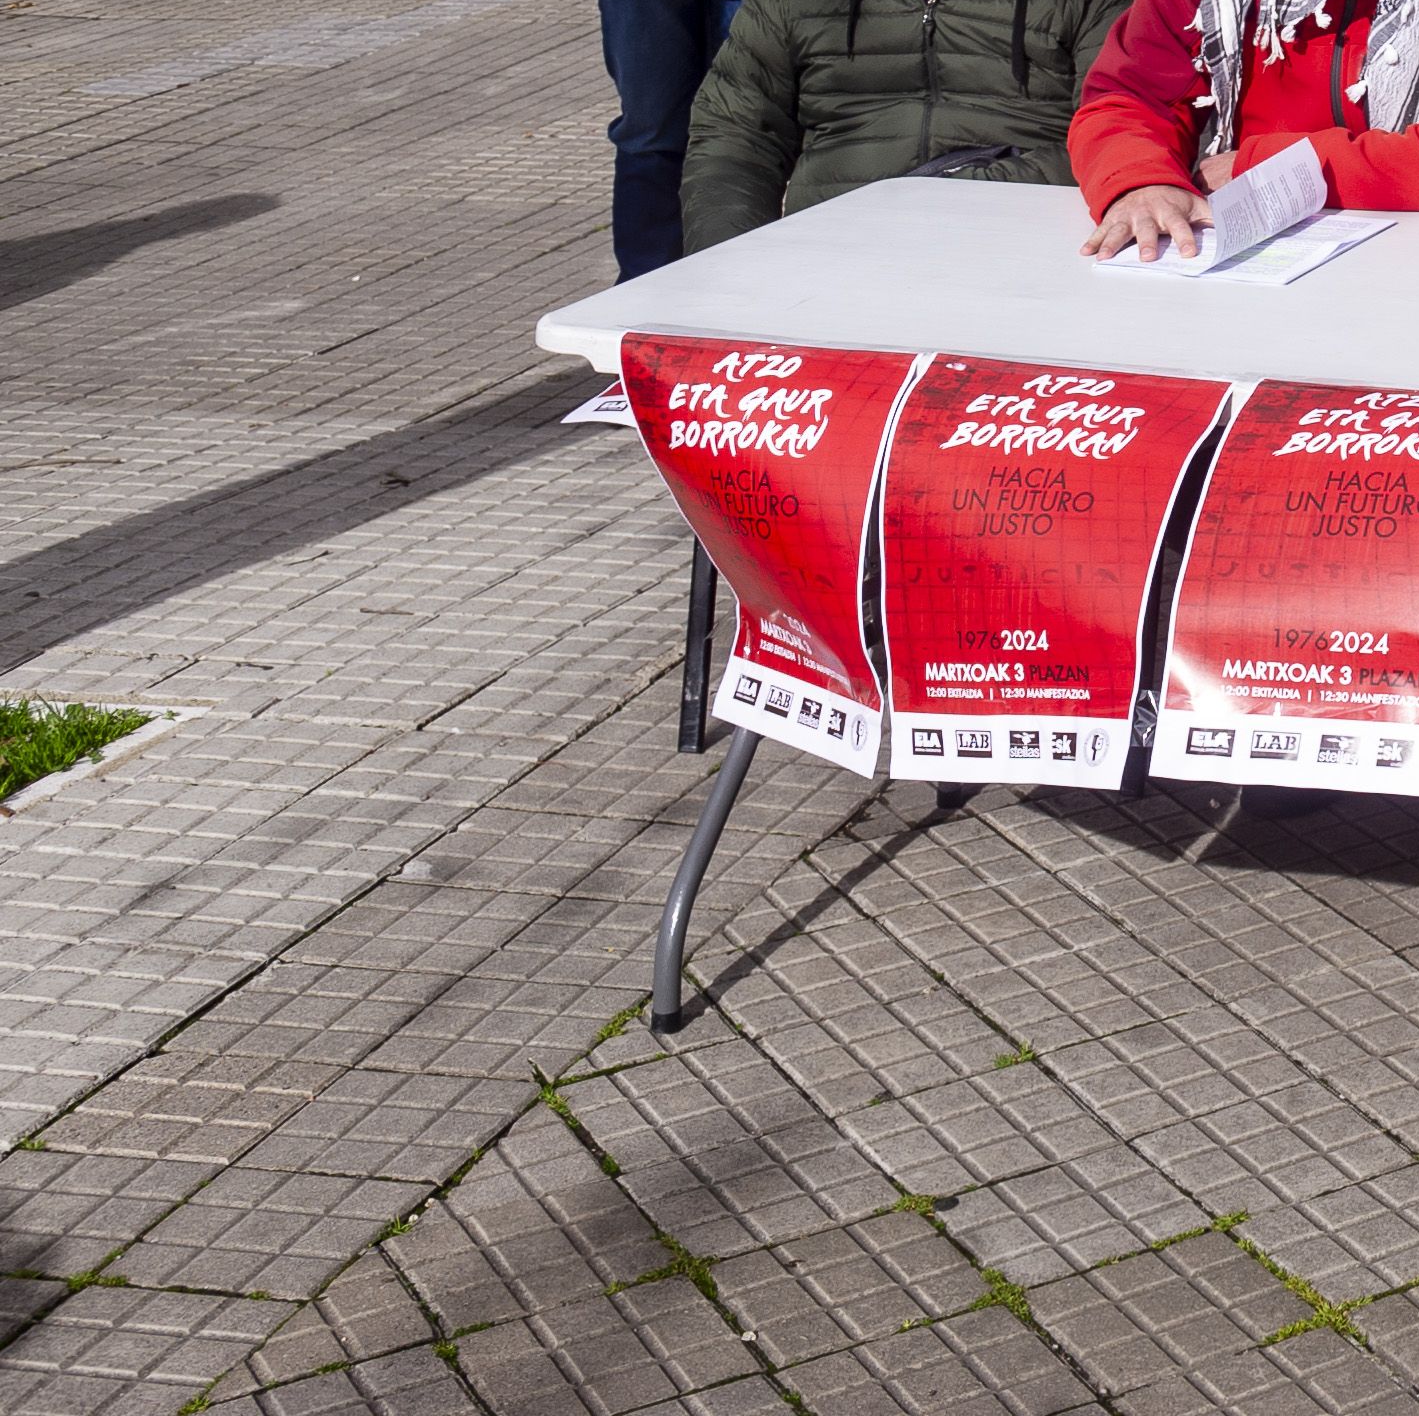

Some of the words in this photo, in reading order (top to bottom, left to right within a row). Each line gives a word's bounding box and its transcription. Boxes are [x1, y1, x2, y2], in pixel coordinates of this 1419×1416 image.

[713, 352, 802, 383] ATZO
[1023, 373, 1115, 397] ATZO
[669, 384, 731, 419] ETA
[739, 388, 833, 422] GAUR
[966, 394, 1039, 423] ETA
[1046, 401, 1146, 431] GAUR
[1298, 411, 1372, 432] ETA
[669, 418, 829, 459] BORROKAN
[939, 422, 1139, 460] BORROKAN
[989, 467, 1066, 489] HACIA
[1325, 471, 1409, 492] HACIA
[953, 488, 986, 511] UN
[998, 491, 1094, 513] FUTURO
[1285, 492, 1326, 512] UN
[978, 513, 1052, 536] JUSTO
[1313, 516, 1397, 537] JUSTO
[1000, 630, 1049, 650] 2024
[1329, 632, 1390, 654] 2024
[925, 663, 1010, 682] MARTXOAK
[1014, 663, 1024, 682] 3
[1029, 664, 1089, 682] PLAZAN
[1222, 659, 1334, 684] MARTXOAK
[1339, 666, 1352, 685] 3
